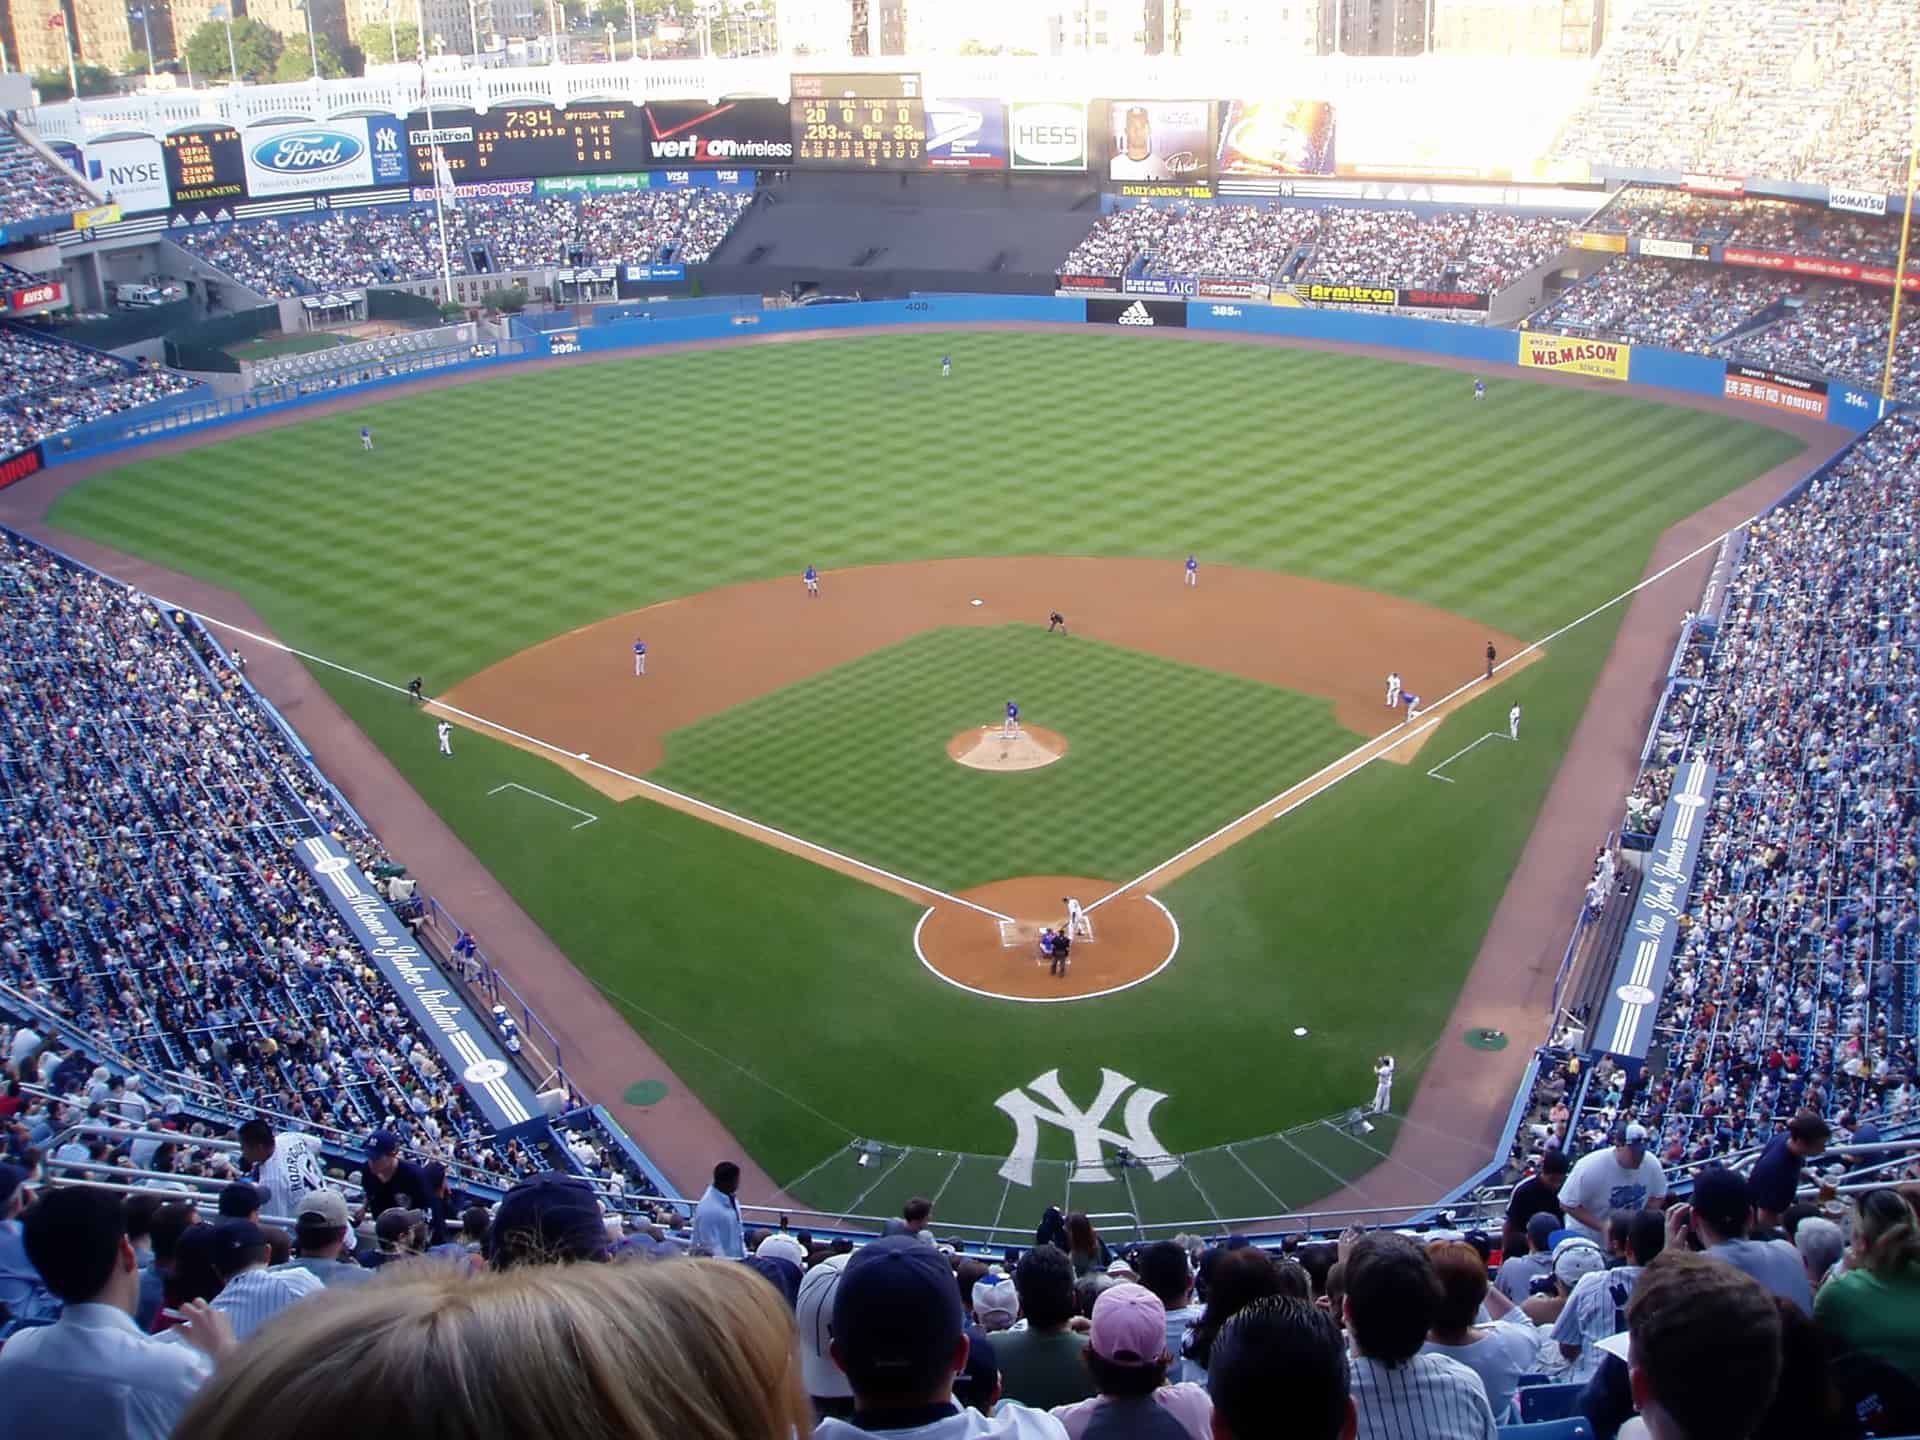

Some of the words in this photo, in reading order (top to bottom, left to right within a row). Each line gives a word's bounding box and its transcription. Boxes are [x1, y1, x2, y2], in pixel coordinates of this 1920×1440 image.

[506, 109, 552, 128] 7:34
[806, 108, 826, 123] 20
[843, 108, 854, 123] 0
[871, 108, 882, 123] 0
[898, 108, 909, 123] 0
[1019, 125, 1077, 145] HESS
[274, 136, 342, 168] Ford
[651, 135, 736, 161] verizon
[735, 140, 792, 158] wireless
[110, 163, 161, 187] NYSE
[666, 171, 689, 181] VISA
[717, 170, 738, 180] VISA
[177, 190, 205, 200] DAILY
[212, 184, 241, 196] NEWS
[480, 182, 531, 195] DONUTS
[1123, 186, 1149, 196] DAILY
[1157, 186, 1182, 197] NEWS
[1831, 193, 1885, 211] KOMATSU
[1172, 281, 1194, 295] AIG
[1311, 284, 1394, 301] Armitron
[1118, 315, 1154, 326] adidas
[551, 343, 573, 355] 399
[1781, 392, 1823, 414] YOMIURI
[1844, 392, 1863, 407] 314
[1642, 880, 1679, 916] York
[348, 894, 388, 936] Welcome
[1635, 914, 1666, 943] New
[376, 936, 399, 946] to
[372, 946, 431, 985] Yankee
[414, 986, 462, 1037] Stadium
[994, 1067, 1182, 1188] NY
